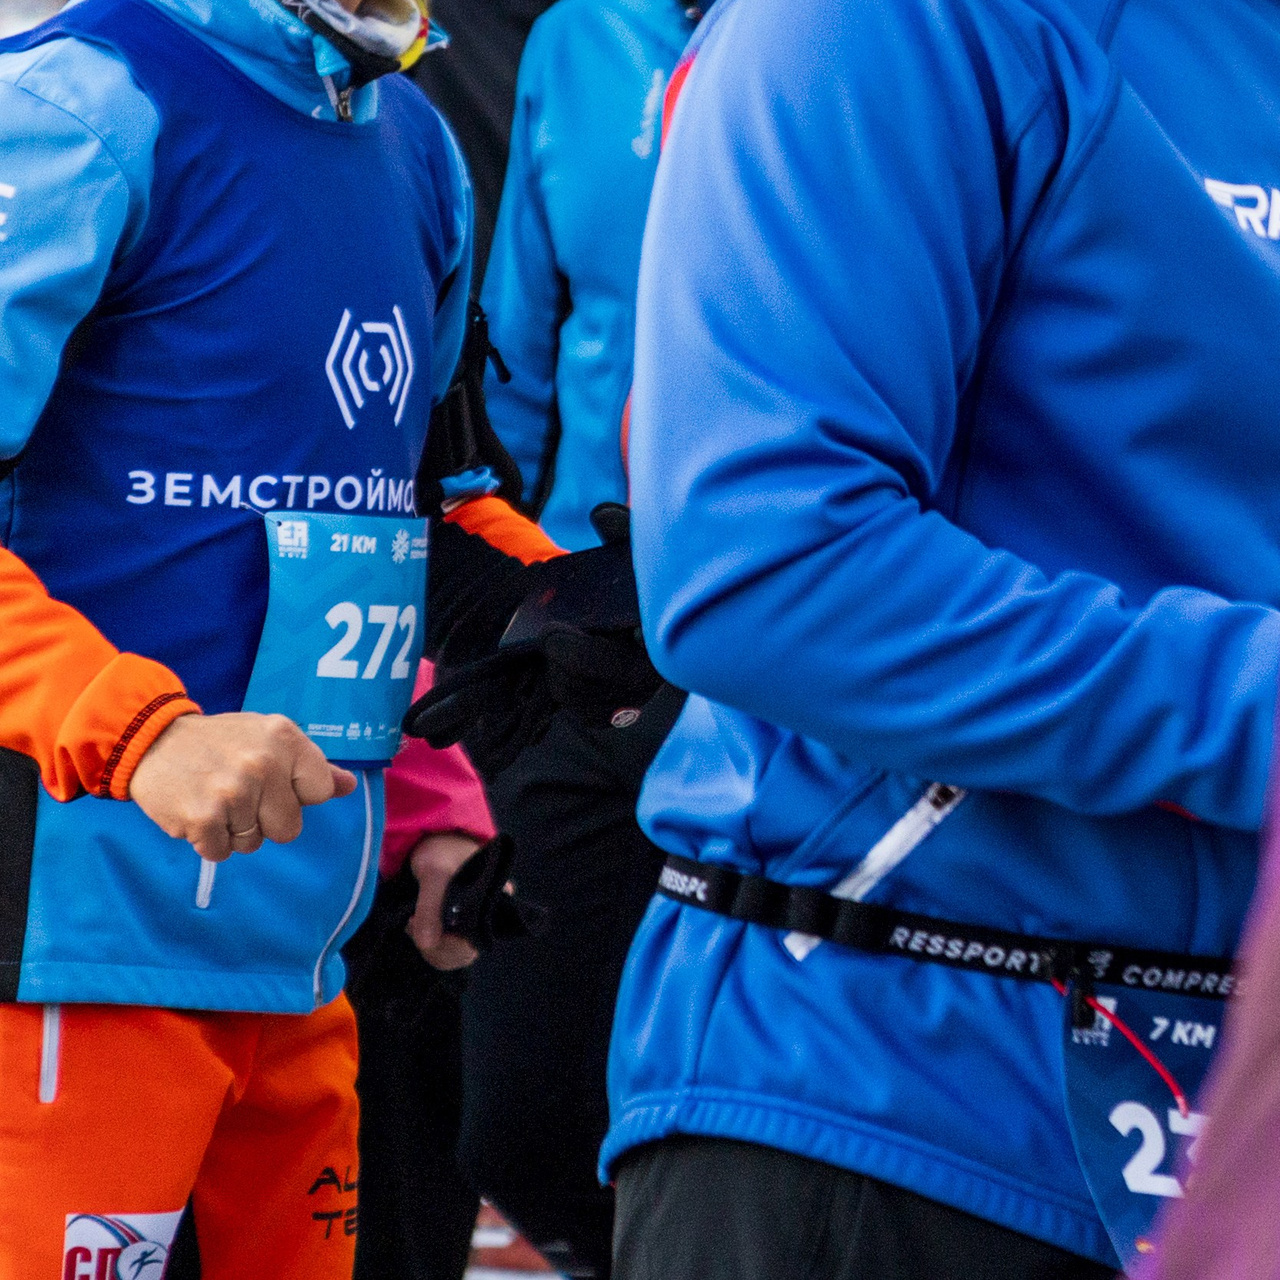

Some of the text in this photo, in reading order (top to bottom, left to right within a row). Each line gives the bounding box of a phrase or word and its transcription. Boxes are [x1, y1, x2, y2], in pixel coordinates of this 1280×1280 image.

[329, 532, 350, 553] 21
[316, 601, 417, 680] 272
[1149, 1015, 1170, 1041] 7
[1170, 1020, 1217, 1050] KM
